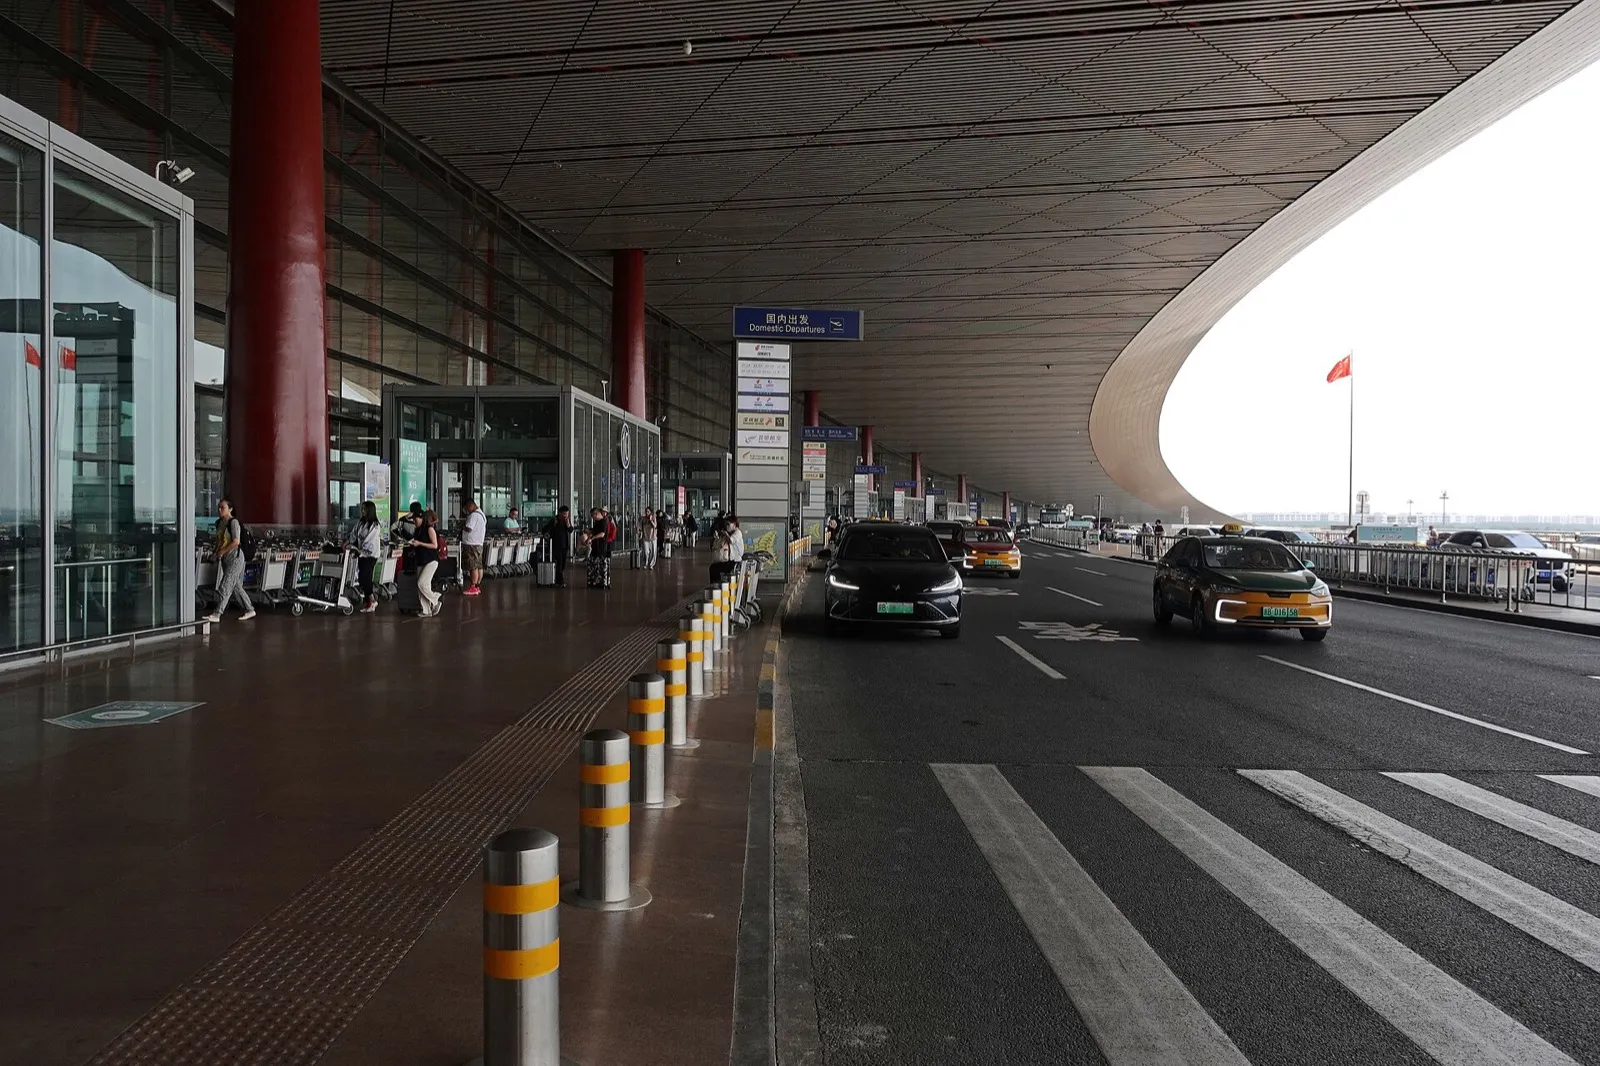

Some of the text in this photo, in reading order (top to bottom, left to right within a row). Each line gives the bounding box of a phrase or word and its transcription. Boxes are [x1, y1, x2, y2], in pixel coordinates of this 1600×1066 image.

[766, 313, 809, 325] 国内出发
[749, 323, 826, 334] Domestic Departures
